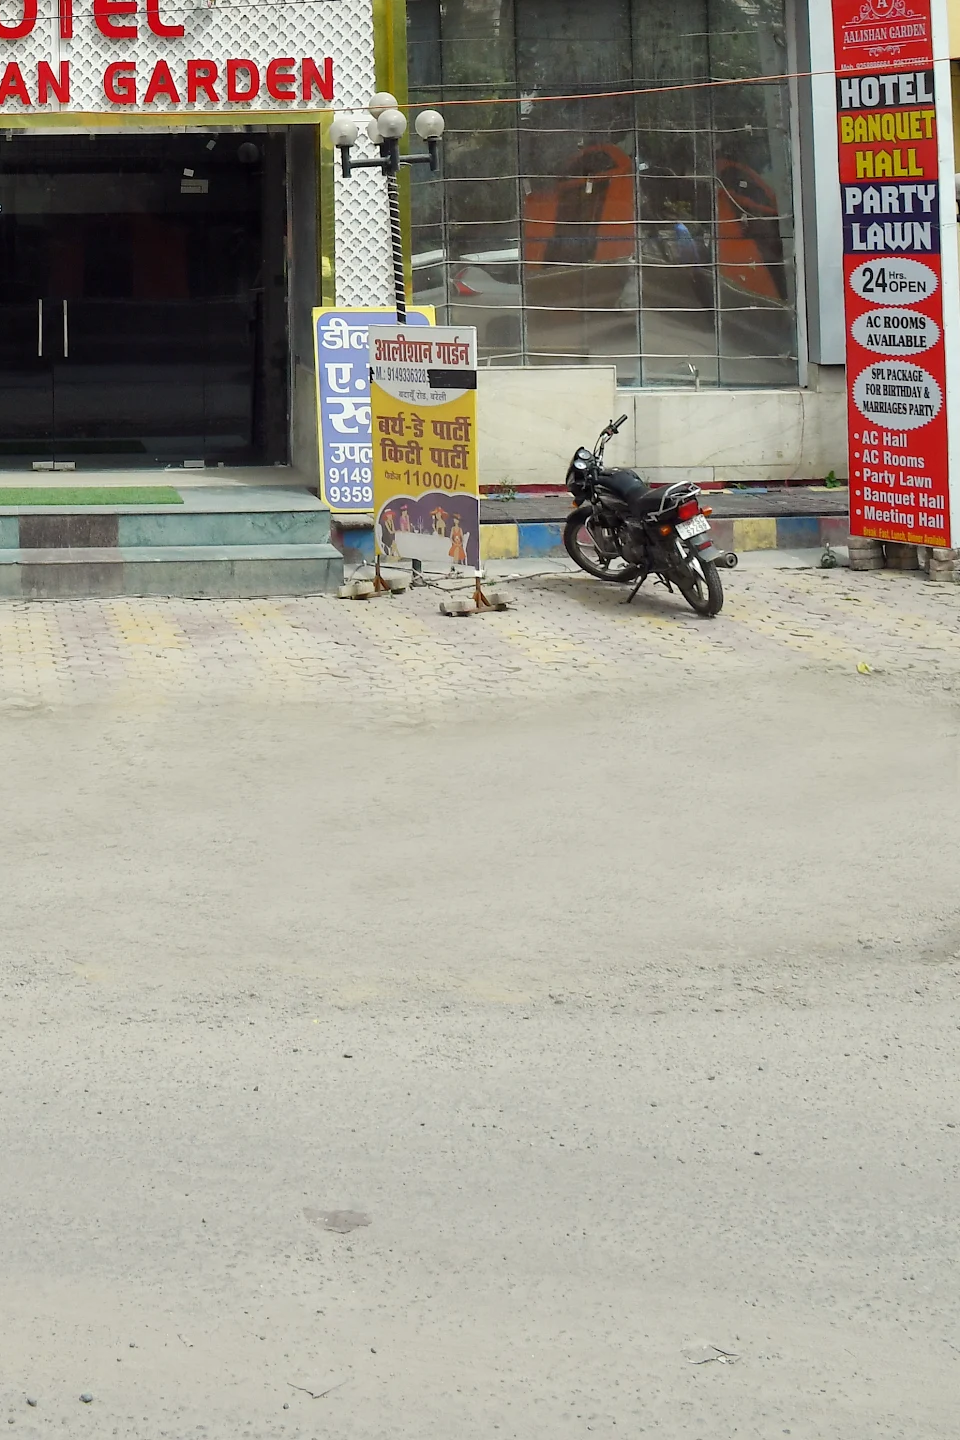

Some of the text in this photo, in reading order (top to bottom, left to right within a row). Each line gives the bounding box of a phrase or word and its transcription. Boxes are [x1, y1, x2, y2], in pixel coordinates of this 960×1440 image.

[843, 23, 926, 44] AALISHAN GARDEN
[103, 57, 334, 104] GARDEN
[840, 72, 933, 109] HOTEL
[841, 109, 935, 144] BANQUET
[855, 148, 924, 178] HALL
[845, 184, 936, 215] PARTY
[851, 221, 932, 251] LAWN
[862, 267, 907, 293] 24 Hrs.
[889, 280, 926, 293] OPEN
[866, 315, 926, 330] AC ROOMS
[375, 334, 470, 365] आलीशान गार्डन
[866, 334, 927, 348] AVAILABLE
[871, 368, 924, 382] SPL PACKAGE
[865, 383, 930, 399] FOR BIRTHDAY &
[862, 400, 934, 417] MARRIAGES PARTY
[431, 416, 471, 442] पार्टी
[862, 430, 907, 448] AC Hall
[380, 437, 469, 470] किटी पार्टी
[862, 449, 925, 468] AC Rooms
[403, 469, 466, 490] 11000/-
[863, 468, 932, 488] Party Lawn
[863, 486, 945, 509] Banquet Hall
[863, 505, 944, 529] Meeting Hall
